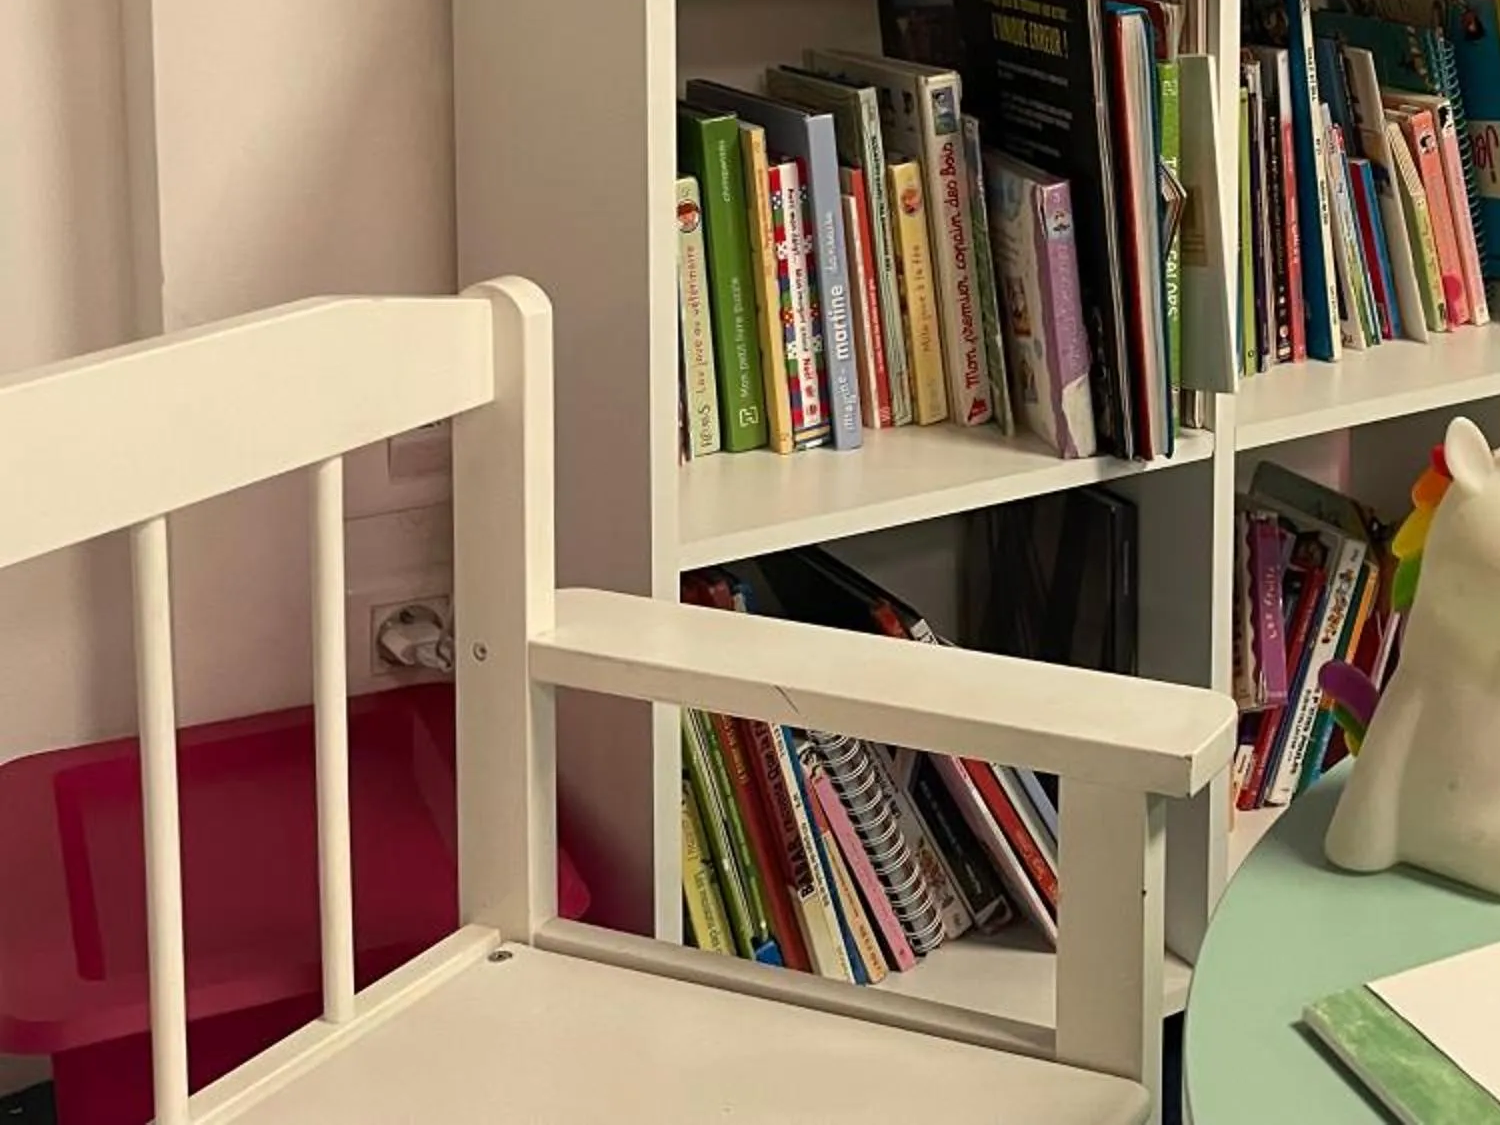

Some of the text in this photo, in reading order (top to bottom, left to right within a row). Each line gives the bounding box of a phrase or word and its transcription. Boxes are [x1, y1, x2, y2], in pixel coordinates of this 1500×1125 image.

[829, 284, 850, 360] martine
[940, 141, 980, 390] Mon premier copain des Bois
